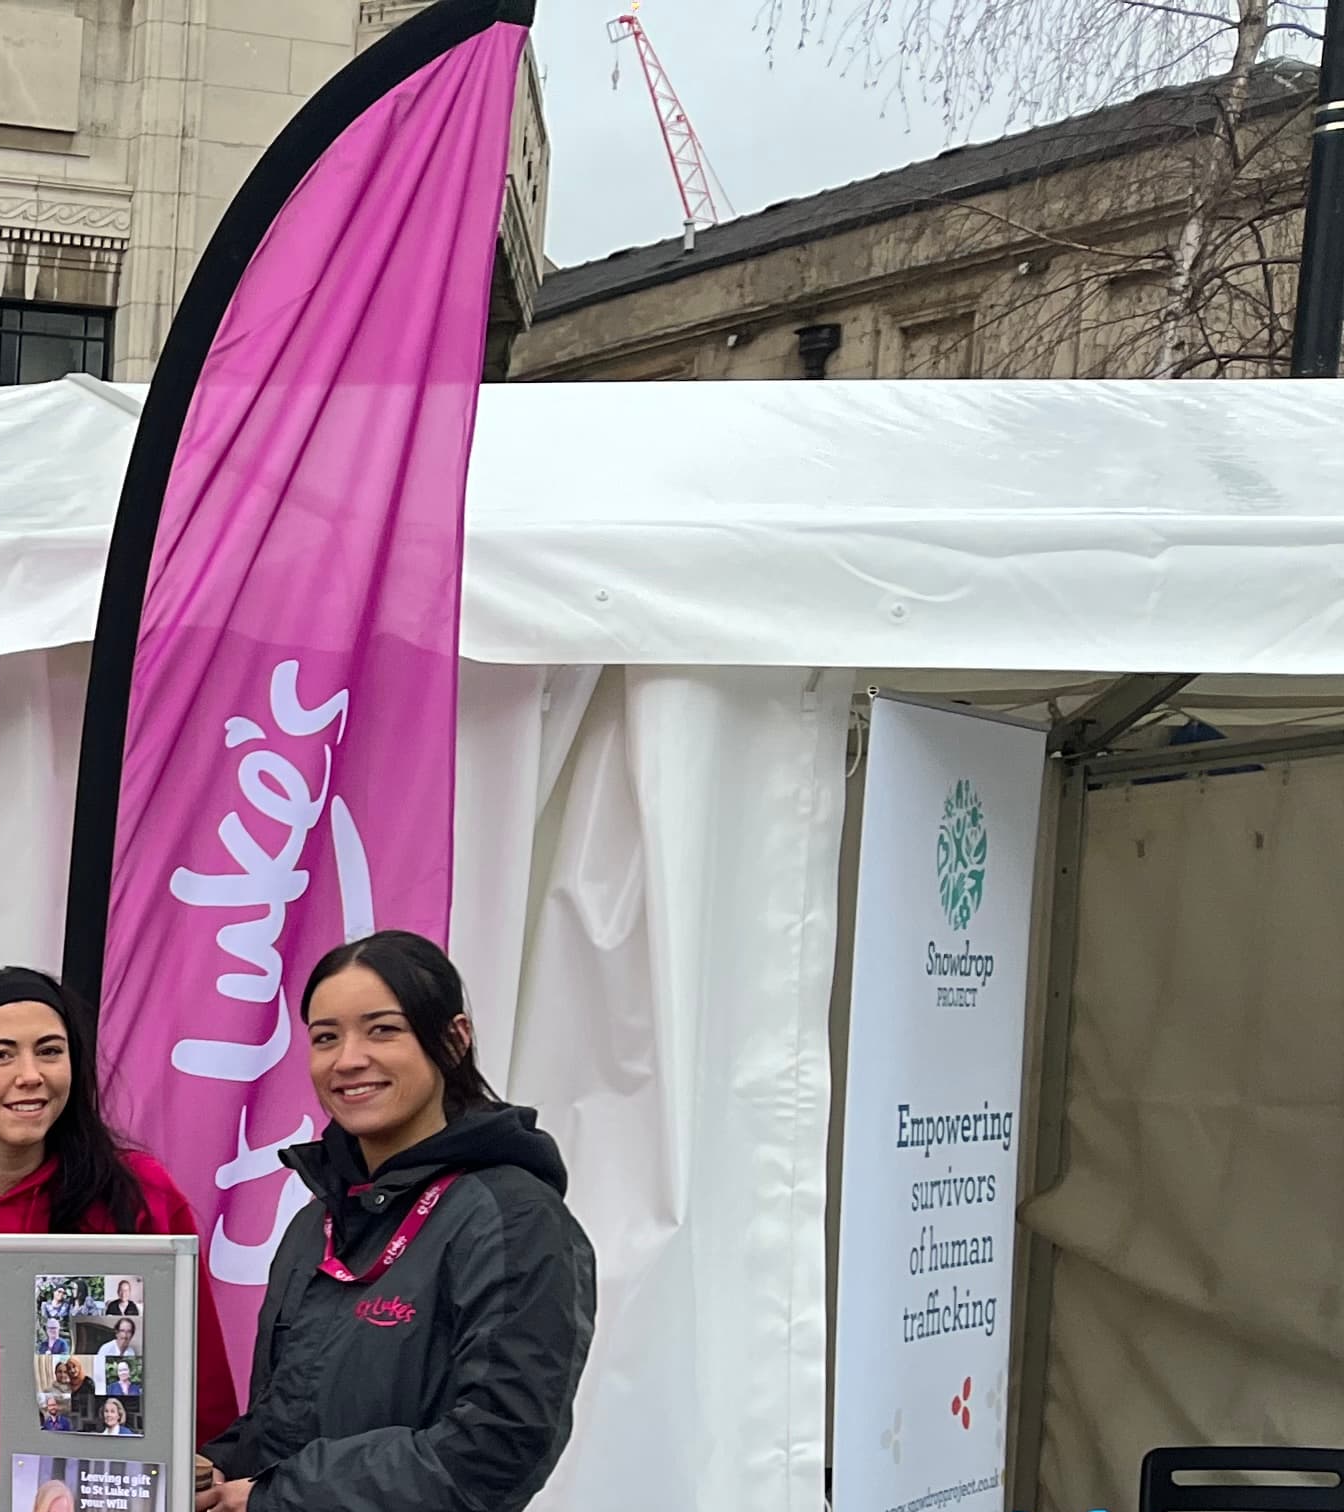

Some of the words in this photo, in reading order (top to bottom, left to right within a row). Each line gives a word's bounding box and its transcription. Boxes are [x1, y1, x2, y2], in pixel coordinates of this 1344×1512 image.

[170, 660, 349, 1082] Luke's
[925, 939, 994, 987] Snowdrop
[936, 987, 978, 1007] PROJECT
[896, 1101, 1014, 1158] Empowering
[911, 1166, 997, 1212] survivors
[909, 1226, 927, 1276] of
[928, 1225, 994, 1272] human
[903, 1285, 998, 1342] trafficking
[80, 1471, 121, 1486] Leaving
[123, 1475, 130, 1484] a
[131, 1473, 151, 1487] gift
[80, 1485, 91, 1494] to
[93, 1485, 103, 1495] St
[104, 1485, 137, 1497] Luke's
[138, 1487, 150, 1498] in
[80, 1498, 105, 1509] your
[106, 1498, 128, 1509] Will
